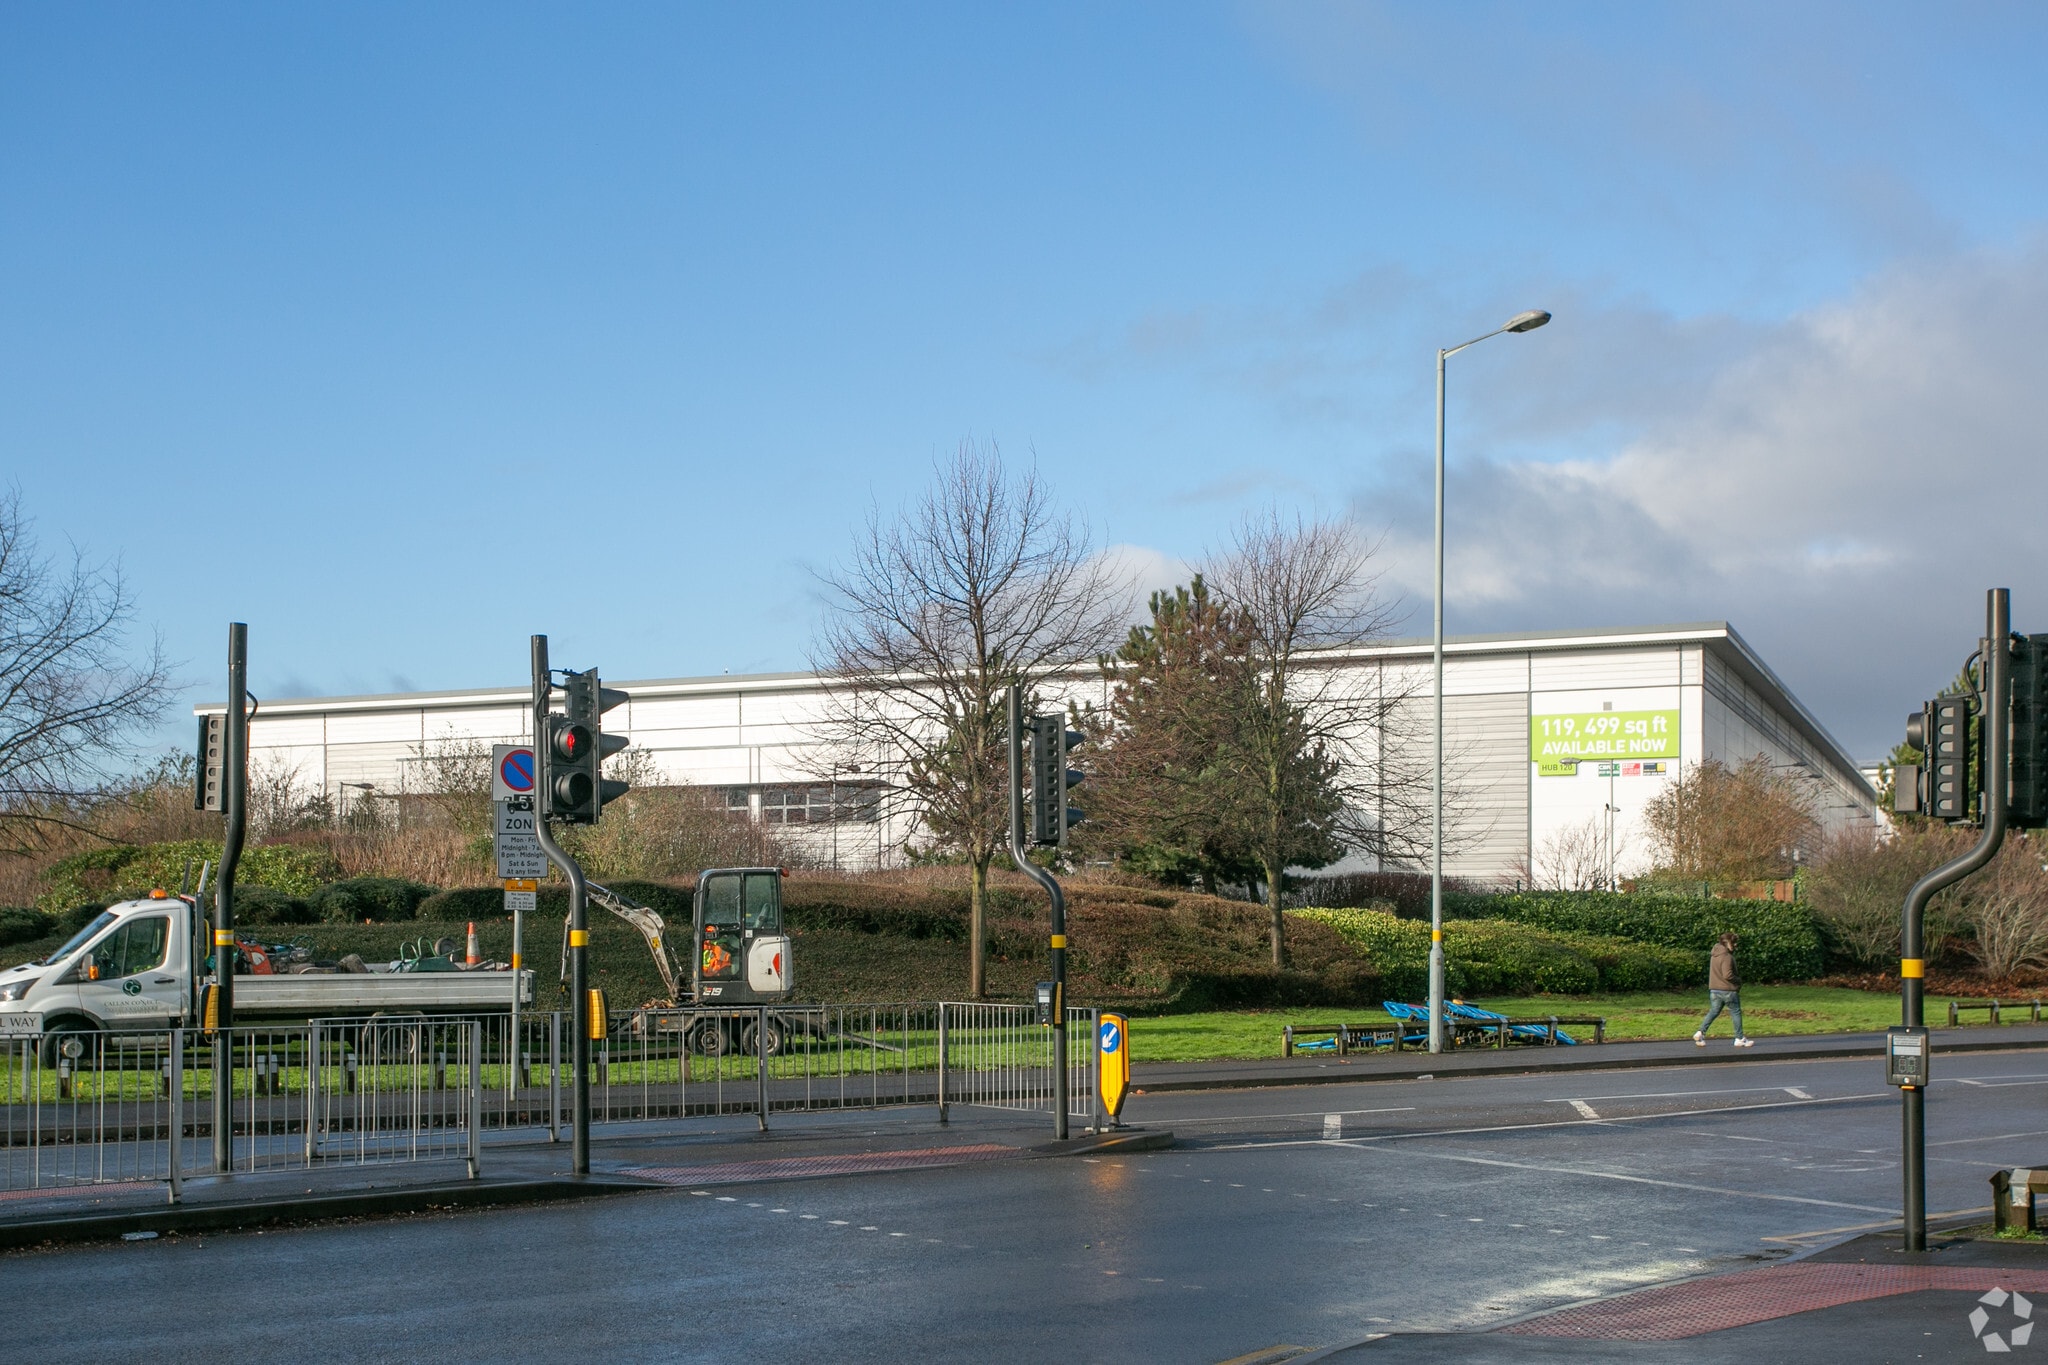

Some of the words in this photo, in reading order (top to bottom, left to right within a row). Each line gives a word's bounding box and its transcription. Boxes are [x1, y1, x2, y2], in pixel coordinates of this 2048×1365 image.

[1541, 718, 1580, 738] 119,
[1585, 716, 1620, 735] 499
[1624, 719, 1648, 738] sq
[1652, 715, 1668, 733] ft
[1541, 739, 1626, 755] AVAILABLE
[1629, 738, 1667, 753] NOW
[505, 818, 532, 829] ZON
[10, 1017, 36, 1027] WAY
